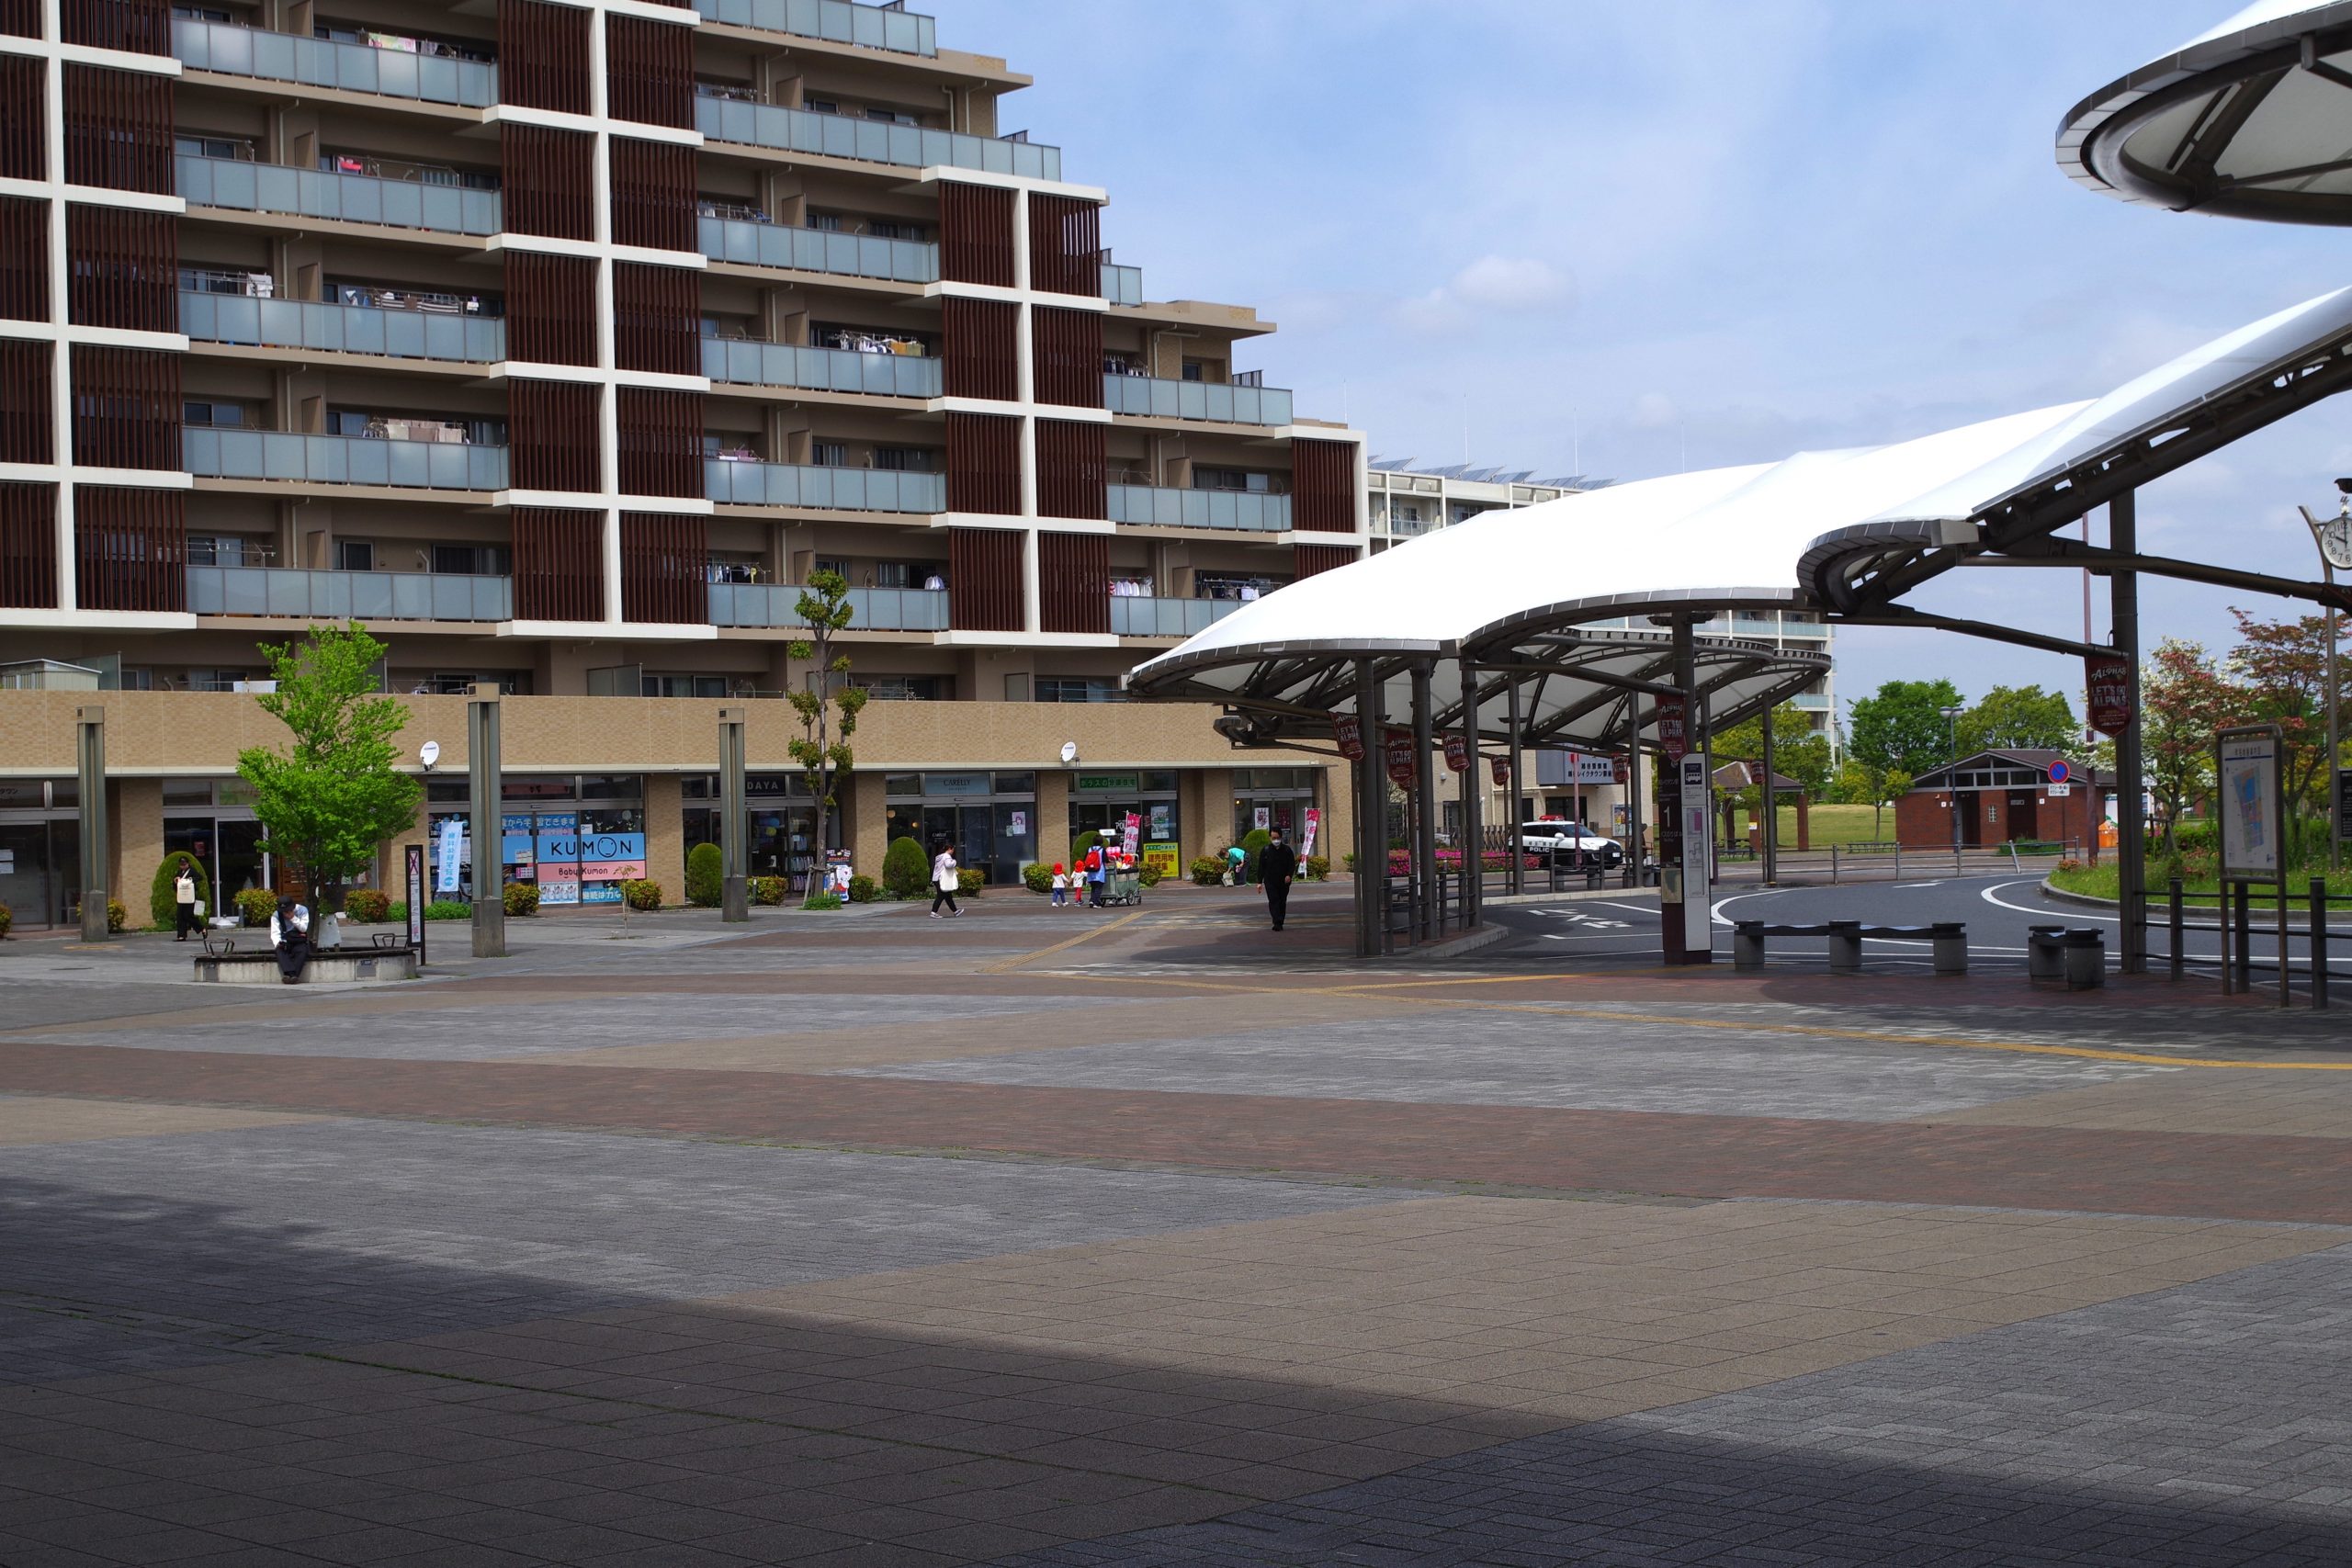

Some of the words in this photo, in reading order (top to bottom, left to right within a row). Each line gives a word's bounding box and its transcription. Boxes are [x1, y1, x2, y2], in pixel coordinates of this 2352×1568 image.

[2091, 667, 2127, 682] ALPHAS
[2094, 695, 2127, 707] ALPHAS
[1663, 806, 1671, 829] 1
[551, 837, 632, 858] KUMON
[559, 867, 581, 879] Baby
[582, 867, 608, 875] Kumon
